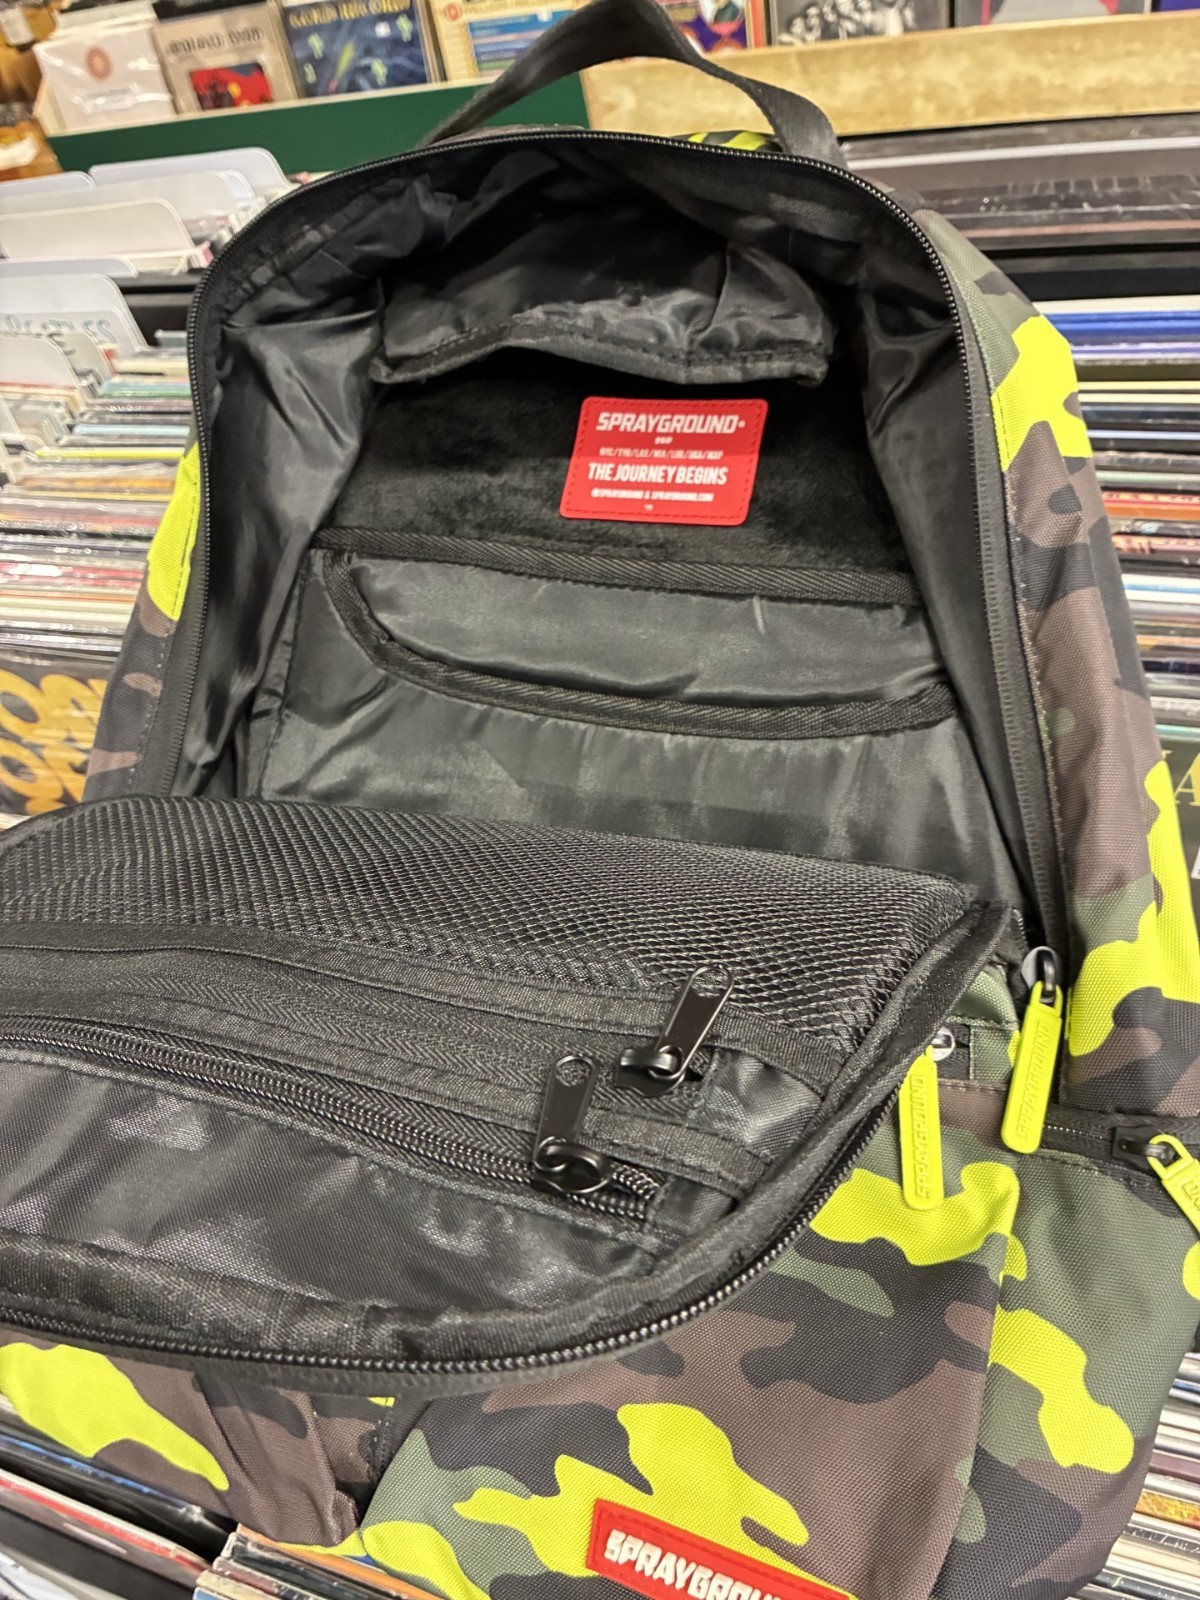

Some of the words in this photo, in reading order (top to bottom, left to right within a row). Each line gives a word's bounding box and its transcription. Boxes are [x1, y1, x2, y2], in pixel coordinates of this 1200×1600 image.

[595, 411, 741, 434] SPRAYGROUND
[588, 461, 614, 481] THE
[614, 463, 677, 484] JOURNEY
[675, 466, 729, 486] BEGINS
[1016, 1021, 1051, 1142] SPRAYGROUND
[909, 1075, 930, 1199] SPRAYGROUND
